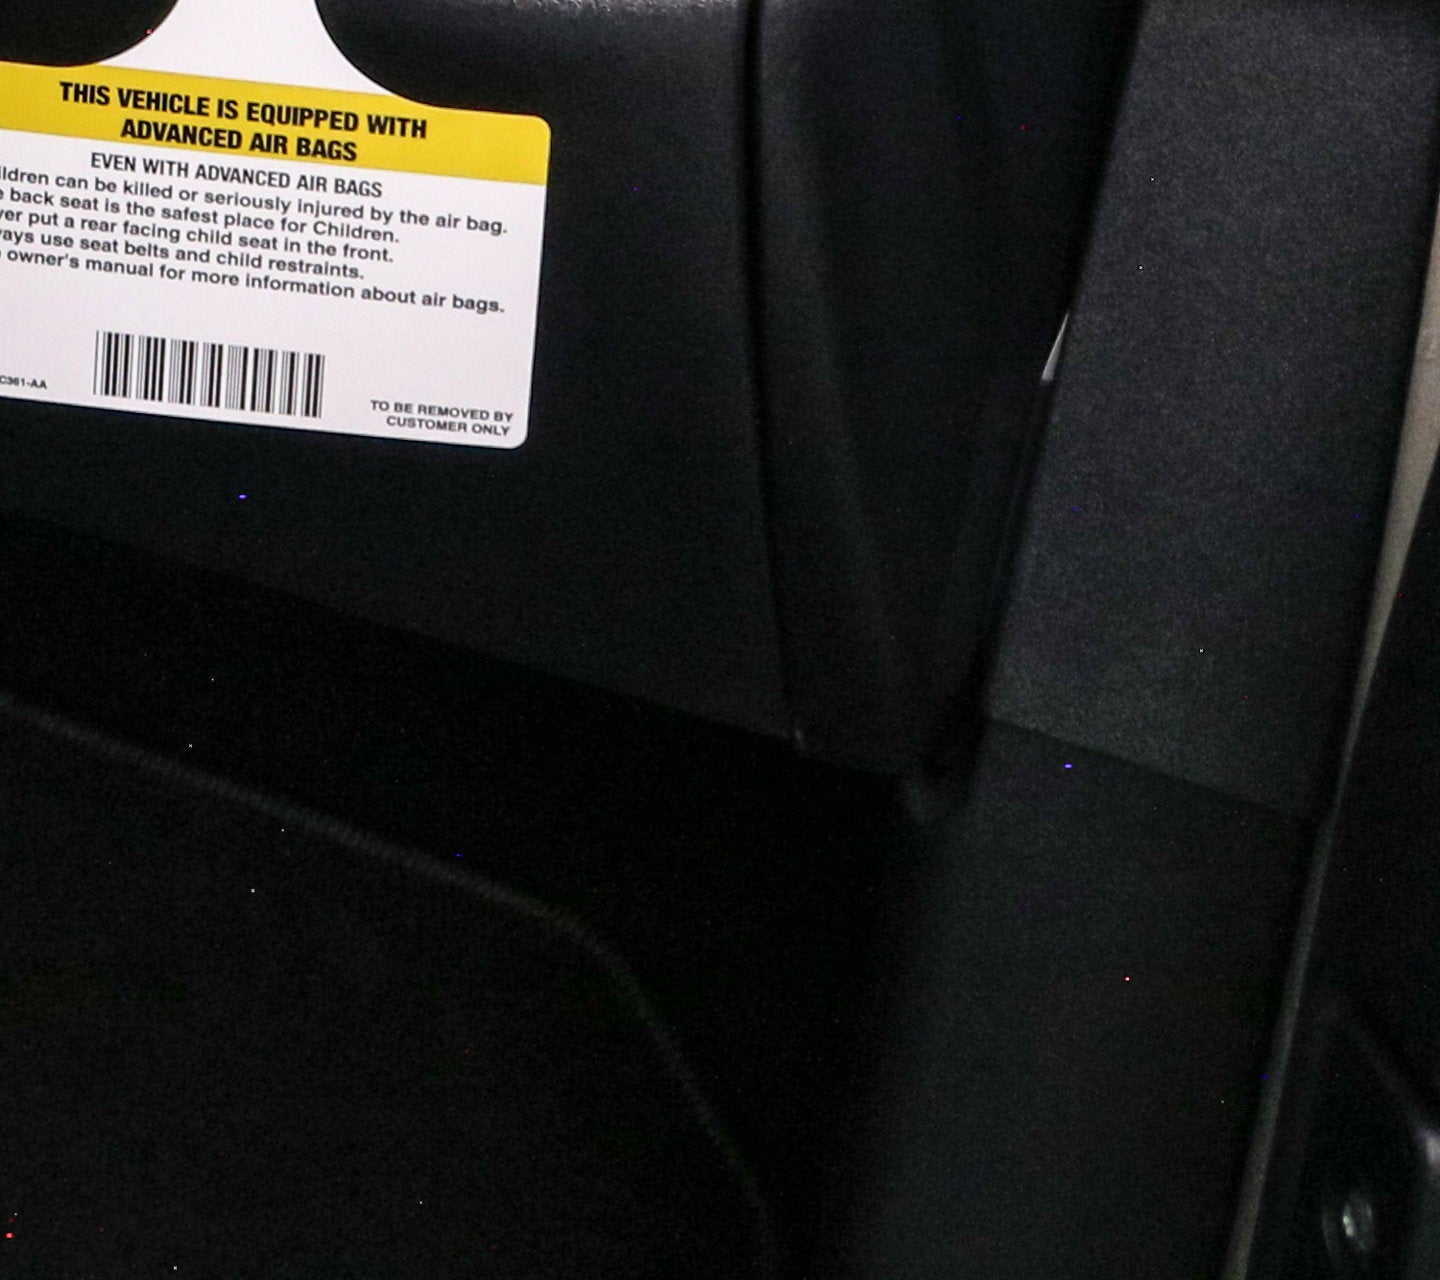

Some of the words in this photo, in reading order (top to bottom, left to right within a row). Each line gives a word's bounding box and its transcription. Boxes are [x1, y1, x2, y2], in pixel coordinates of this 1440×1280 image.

[59, 81, 111, 106] THIS
[117, 87, 210, 117] VEHICLE
[216, 98, 239, 121] IS
[246, 101, 360, 131] EQUIPPED
[367, 113, 428, 139] WITH
[120, 118, 242, 151] ADVANCED
[249, 132, 289, 155] AIR
[296, 138, 358, 162] BAGS
[90, 151, 136, 172] EVEN
[142, 157, 190, 179] WITH
[195, 163, 290, 188] ADVANCED
[296, 174, 328, 192] AIR
[334, 178, 383, 198] BAGS
[10, 185, 55, 207] back
[60, 194, 99, 212] seat
[104, 198, 121, 214] is
[126, 200, 156, 218] the
[161, 205, 219, 226] safest
[223, 213, 275, 233] place
[280, 217, 308, 234] for
[312, 221, 401, 244] Children.
[54, 175, 88, 190] can
[94, 177, 118, 193] be
[123, 180, 174, 200] killed
[179, 189, 200, 203] or
[204, 188, 292, 215] seriously
[297, 198, 364, 220] injured
[370, 207, 395, 226] by
[400, 210, 430, 226] the
[435, 213, 462, 230] air
[466, 216, 509, 237] bag.
[28, 211, 59, 229] put
[64, 216, 75, 229] a
[80, 218, 118, 234] rear
[123, 221, 181, 244] facing
[185, 228, 232, 247] child
[238, 236, 278, 252] seat
[283, 239, 302, 255] in
[307, 241, 337, 258] the
[343, 244, 394, 264] front.
[40, 232, 74, 248] use
[79, 236, 120, 254] seat
[124, 241, 170, 260] belts
[175, 246, 211, 264] and
[216, 251, 263, 269] child
[267, 257, 365, 280] restraints.
[6, 250, 80, 270] owner's
[85, 257, 154, 278] manual
[159, 263, 185, 281] for
[191, 270, 240, 287] more
[245, 273, 356, 299] information
[360, 287, 417, 306] about
[421, 290, 448, 308] air
[452, 294, 506, 315] bags.
[370, 399, 390, 412] TO
[393, 401, 413, 414] BE
[417, 404, 490, 421] REMOVED
[493, 411, 514, 423] BY
[386, 415, 468, 433] CUSTOMER
[471, 423, 511, 436] ONLY
